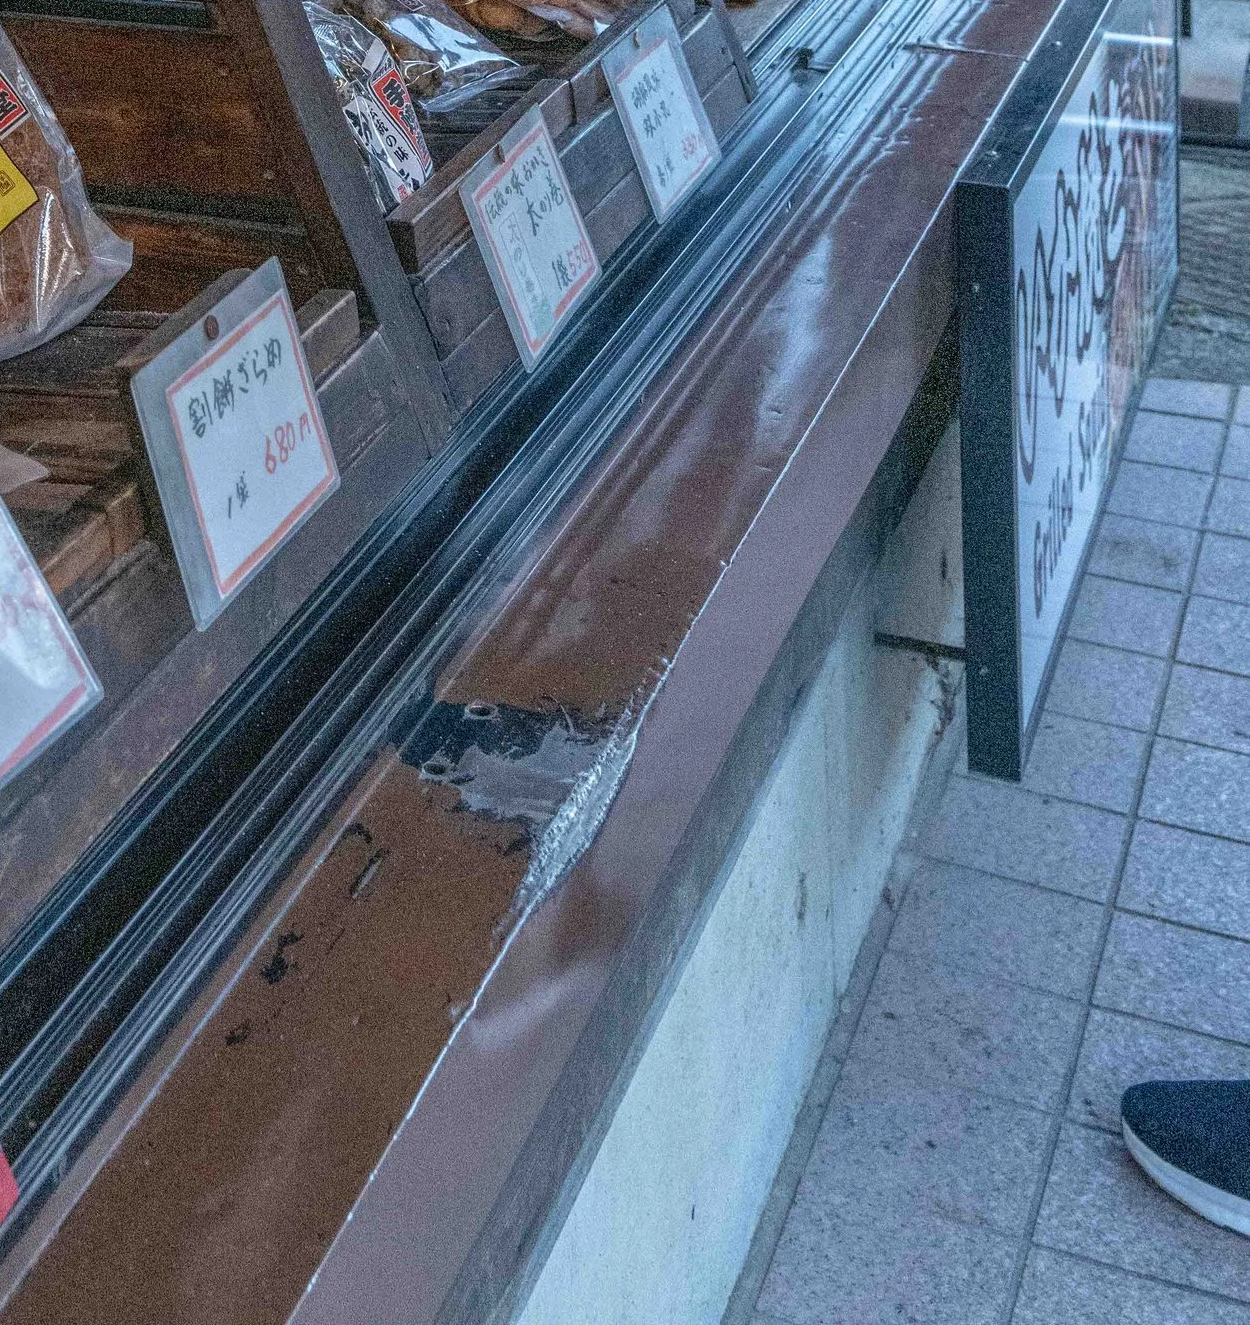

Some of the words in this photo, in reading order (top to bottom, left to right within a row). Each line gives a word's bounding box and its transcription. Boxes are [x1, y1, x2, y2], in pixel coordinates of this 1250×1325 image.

[186, 336, 283, 440] 割餅ざらめ
[263, 412, 312, 476] 680円
[1033, 430, 1074, 619] Grilled
